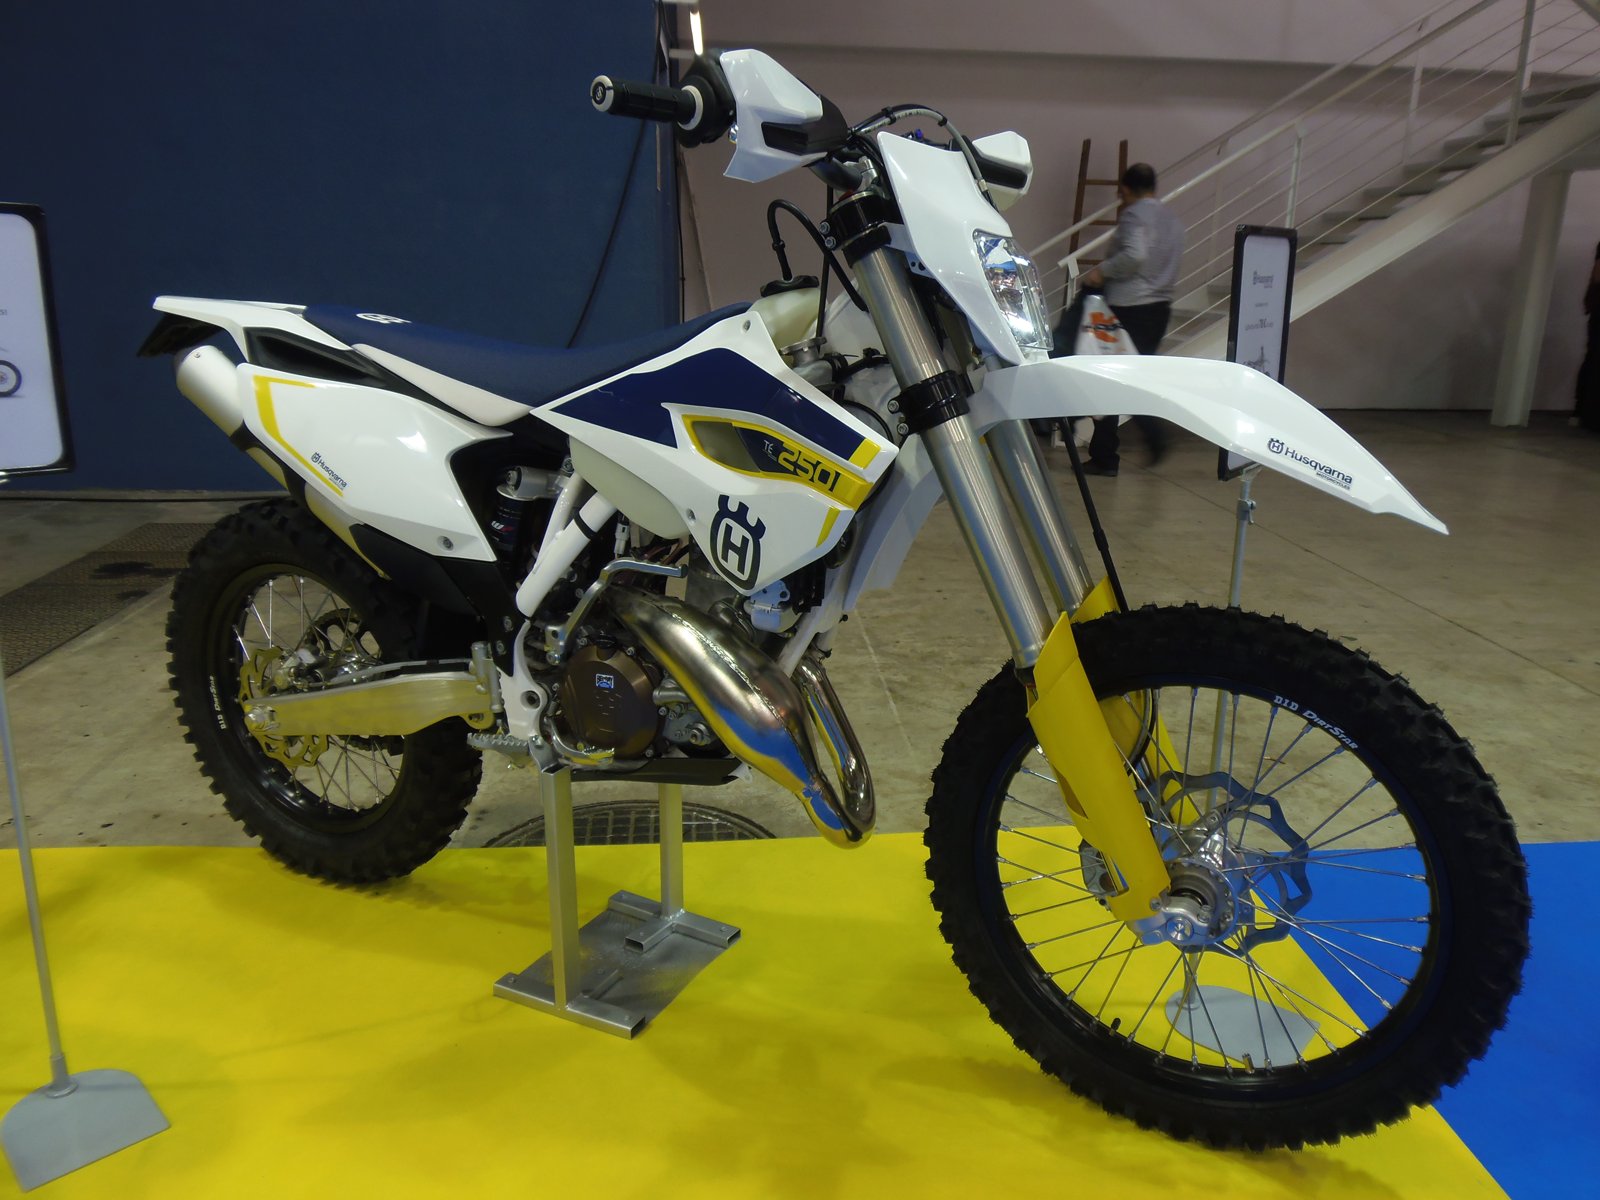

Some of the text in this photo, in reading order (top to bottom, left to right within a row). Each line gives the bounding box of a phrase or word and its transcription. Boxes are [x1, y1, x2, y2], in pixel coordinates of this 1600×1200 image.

[763, 440, 774, 454] TE
[318, 459, 347, 488] Husqvarna
[1285, 446, 1353, 484] Husqvarna
[1273, 695, 1299, 711] DID
